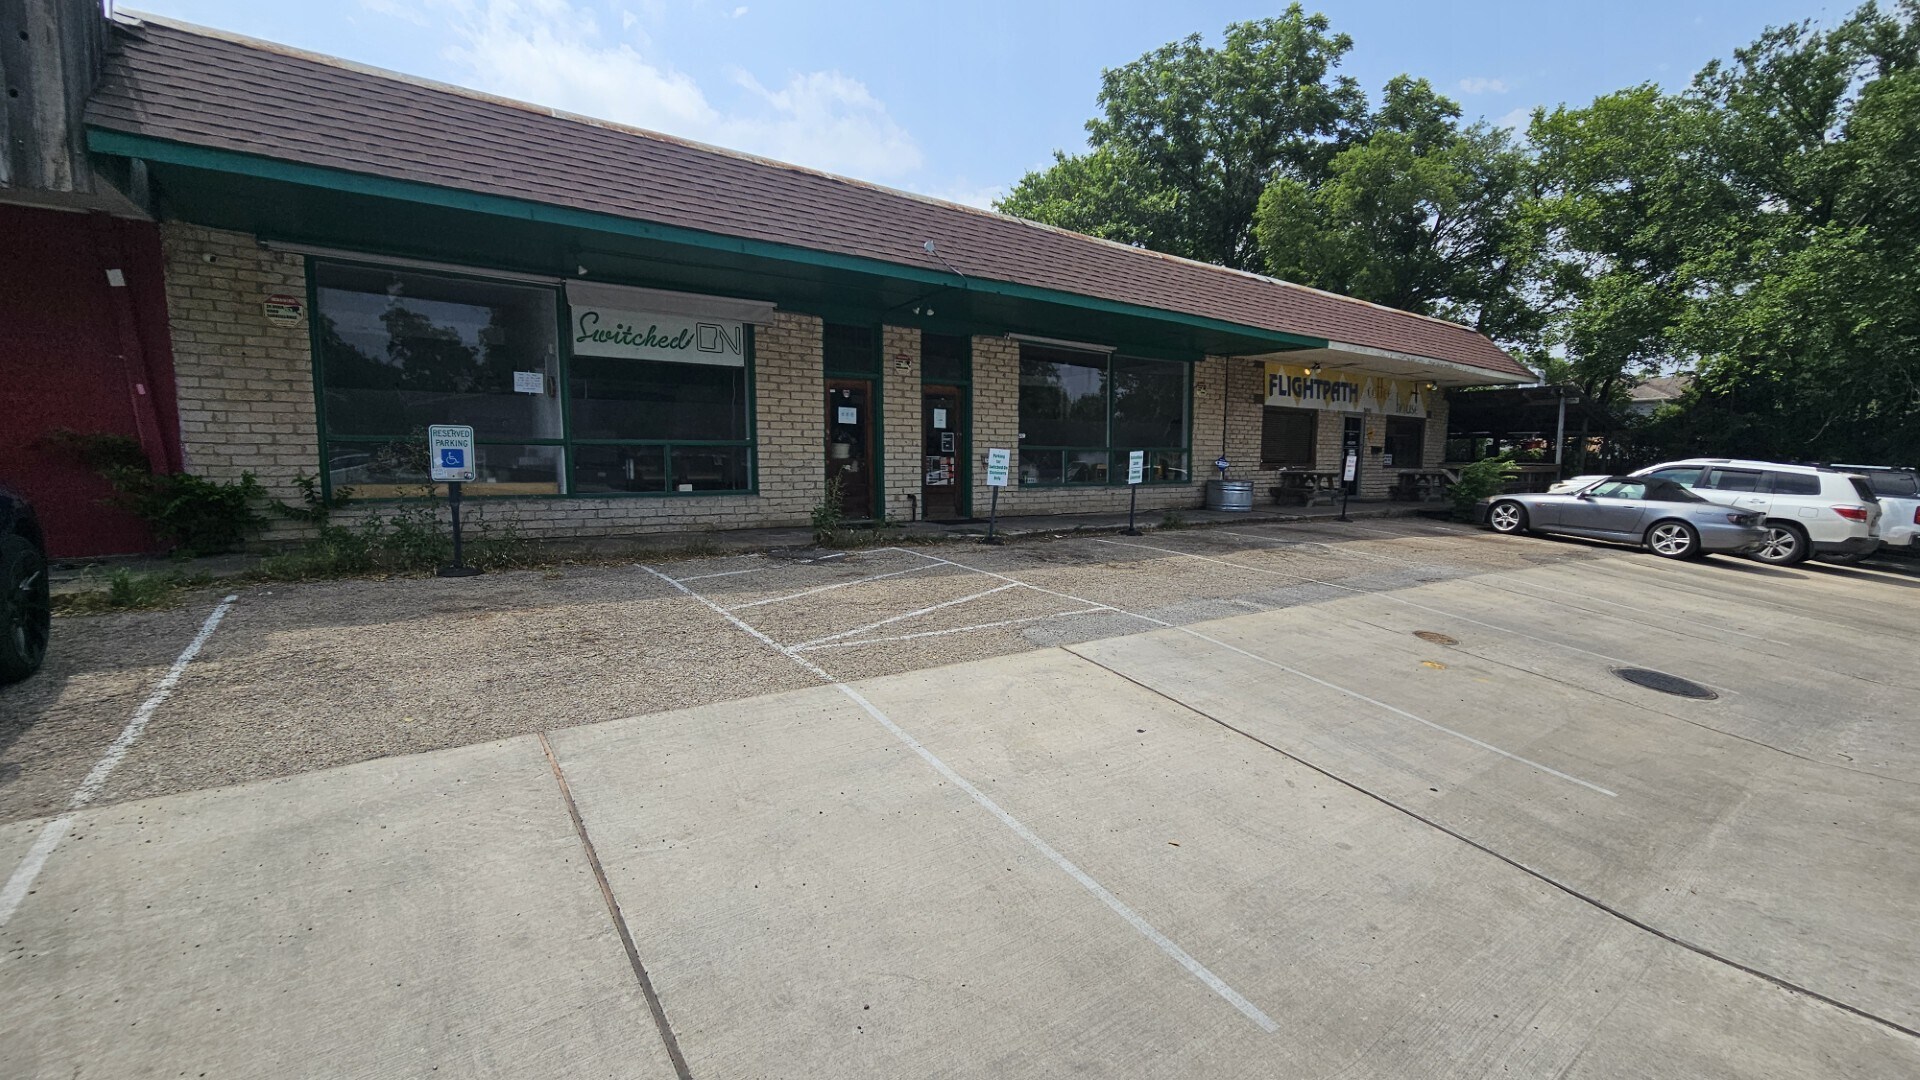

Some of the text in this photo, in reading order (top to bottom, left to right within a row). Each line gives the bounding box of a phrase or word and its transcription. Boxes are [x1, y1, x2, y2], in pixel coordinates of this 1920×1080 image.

[576, 311, 741, 355] Switched ON
[1268, 373, 1359, 402] FLIGHTPATH
[432, 429, 470, 438] RESERVED
[435, 439, 469, 448] PARKING
